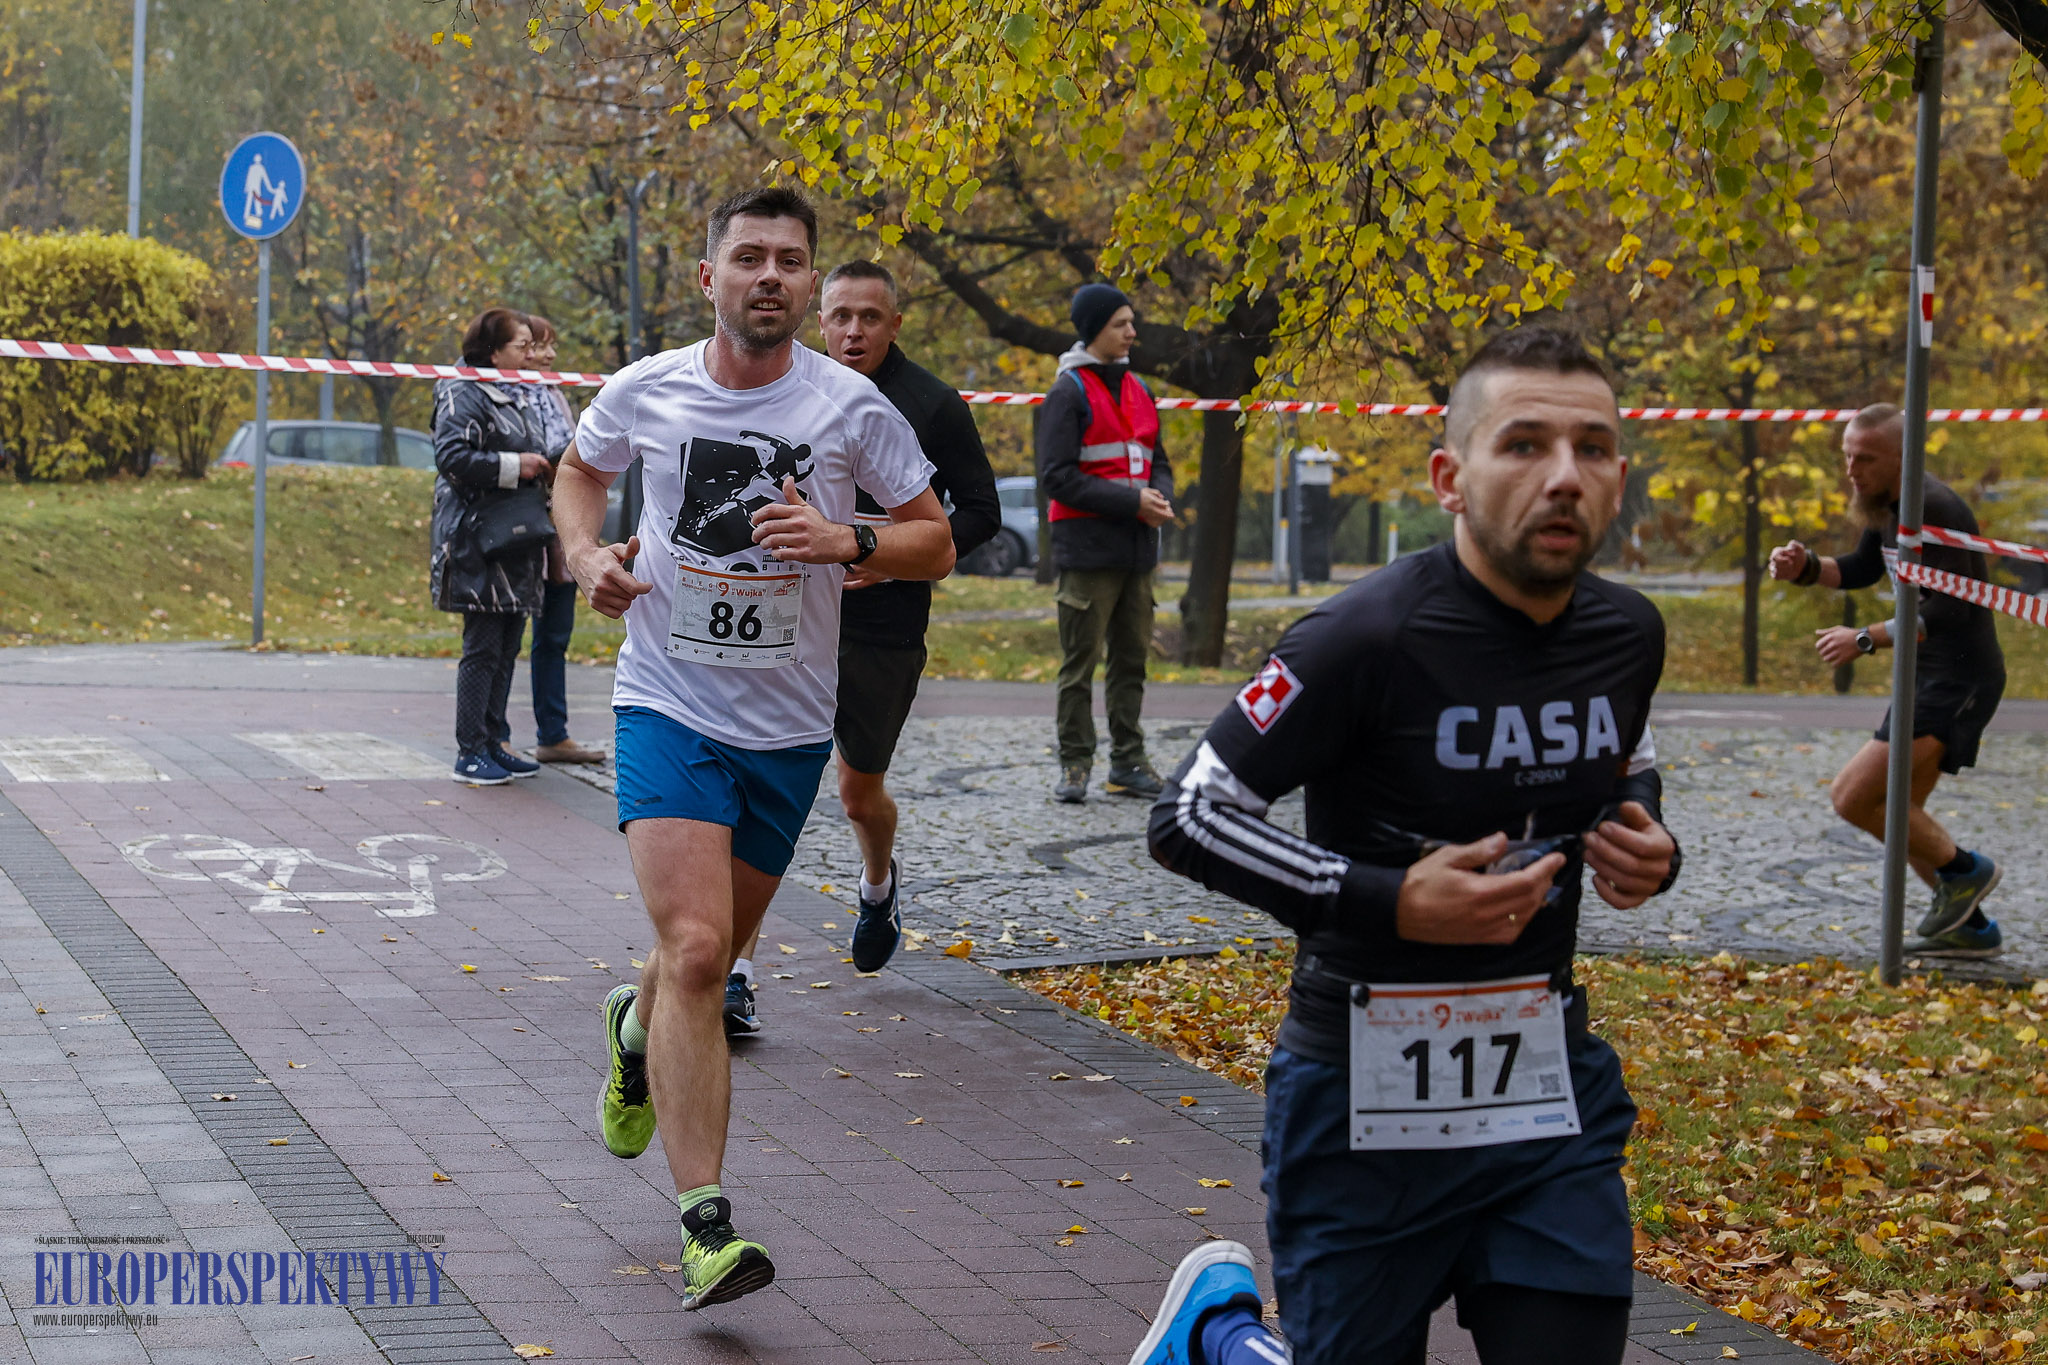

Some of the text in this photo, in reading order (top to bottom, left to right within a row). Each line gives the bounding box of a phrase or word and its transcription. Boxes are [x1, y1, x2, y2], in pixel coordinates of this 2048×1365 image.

[717, 581, 730, 597] 9
[708, 601, 762, 641] 86
[1434, 695, 1621, 770] CASA
[1401, 1032, 1521, 1100] 117
